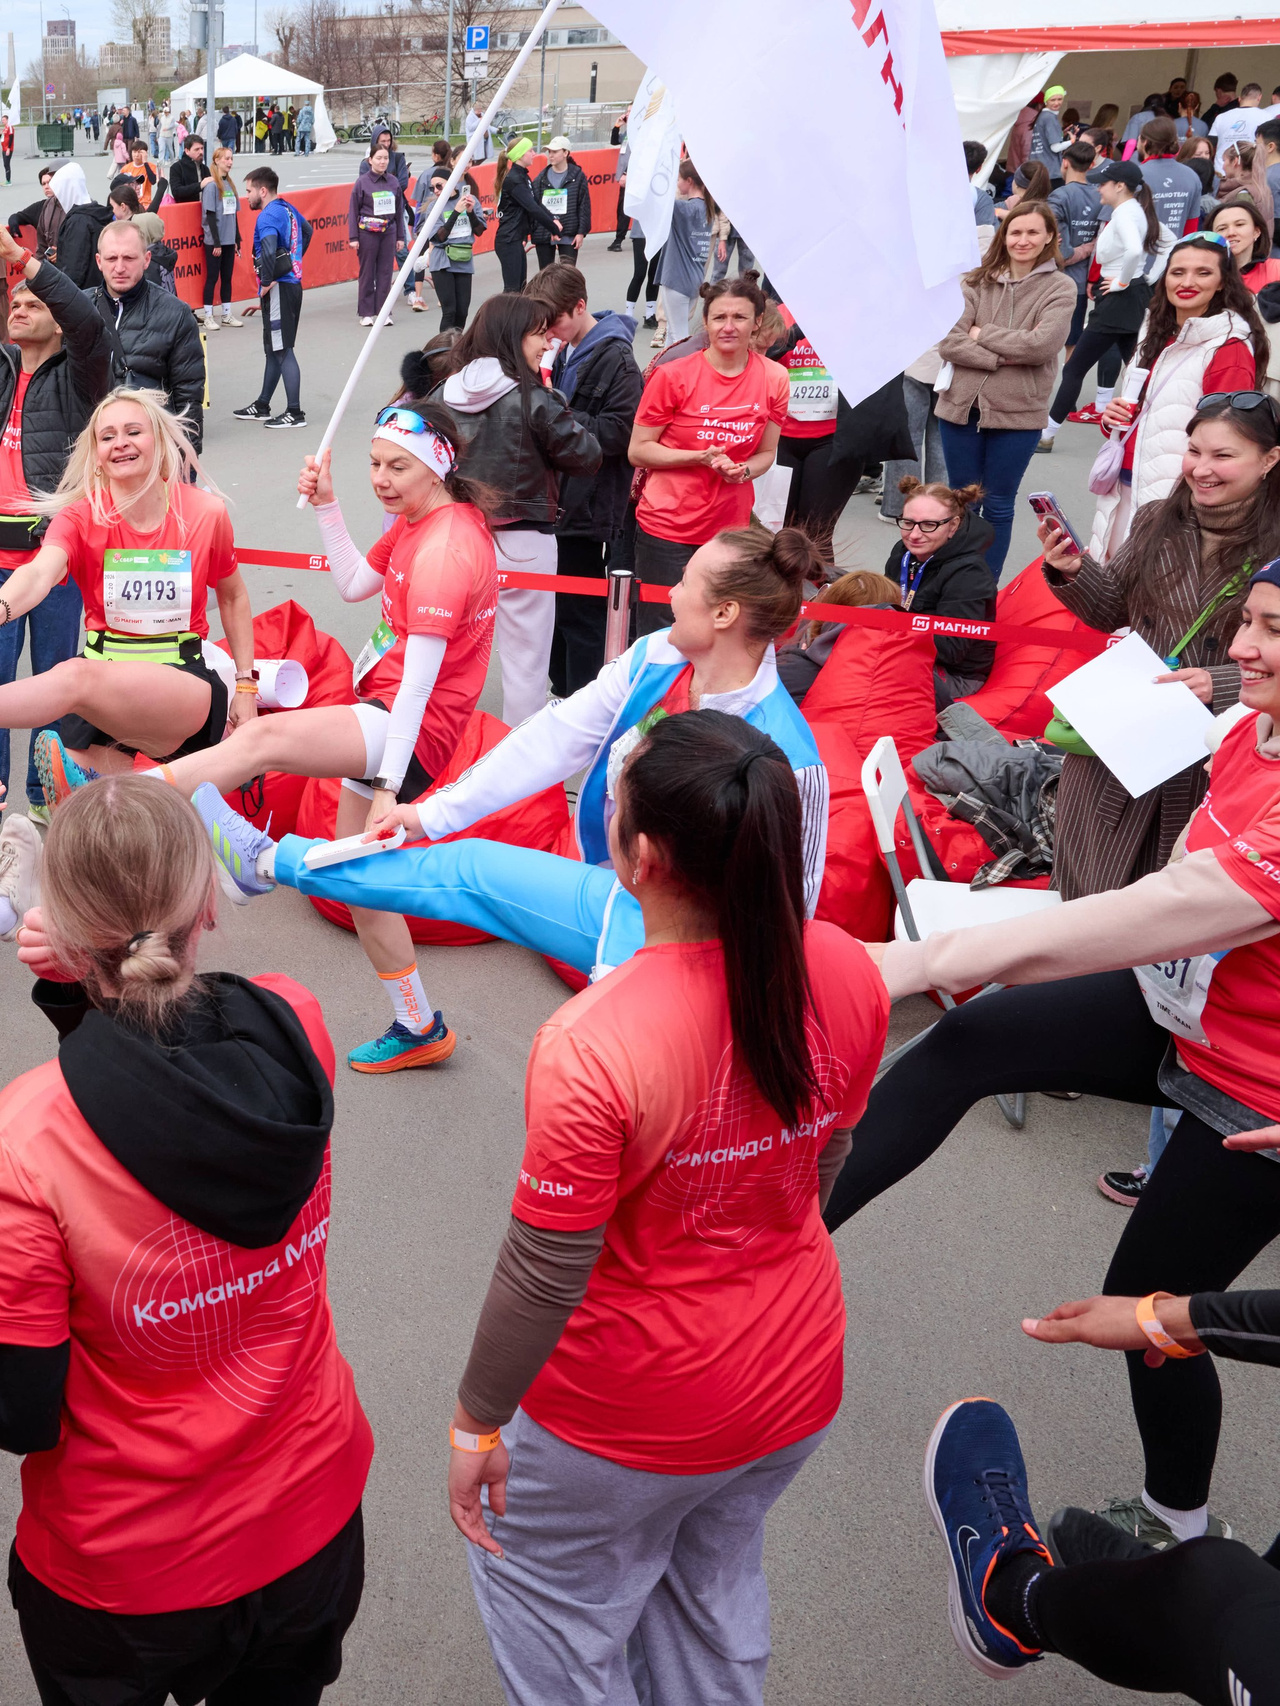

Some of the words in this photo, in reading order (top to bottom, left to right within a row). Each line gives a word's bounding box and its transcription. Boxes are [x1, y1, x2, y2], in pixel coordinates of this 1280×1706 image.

[793, 385, 830, 399] 49228
[696, 430, 716, 441] за
[121, 580, 176, 601] 49193
[933, 620, 991, 636] МАГНИТ
[664, 1136, 773, 1169] Команда
[132, 1258, 282, 1329] Команда
